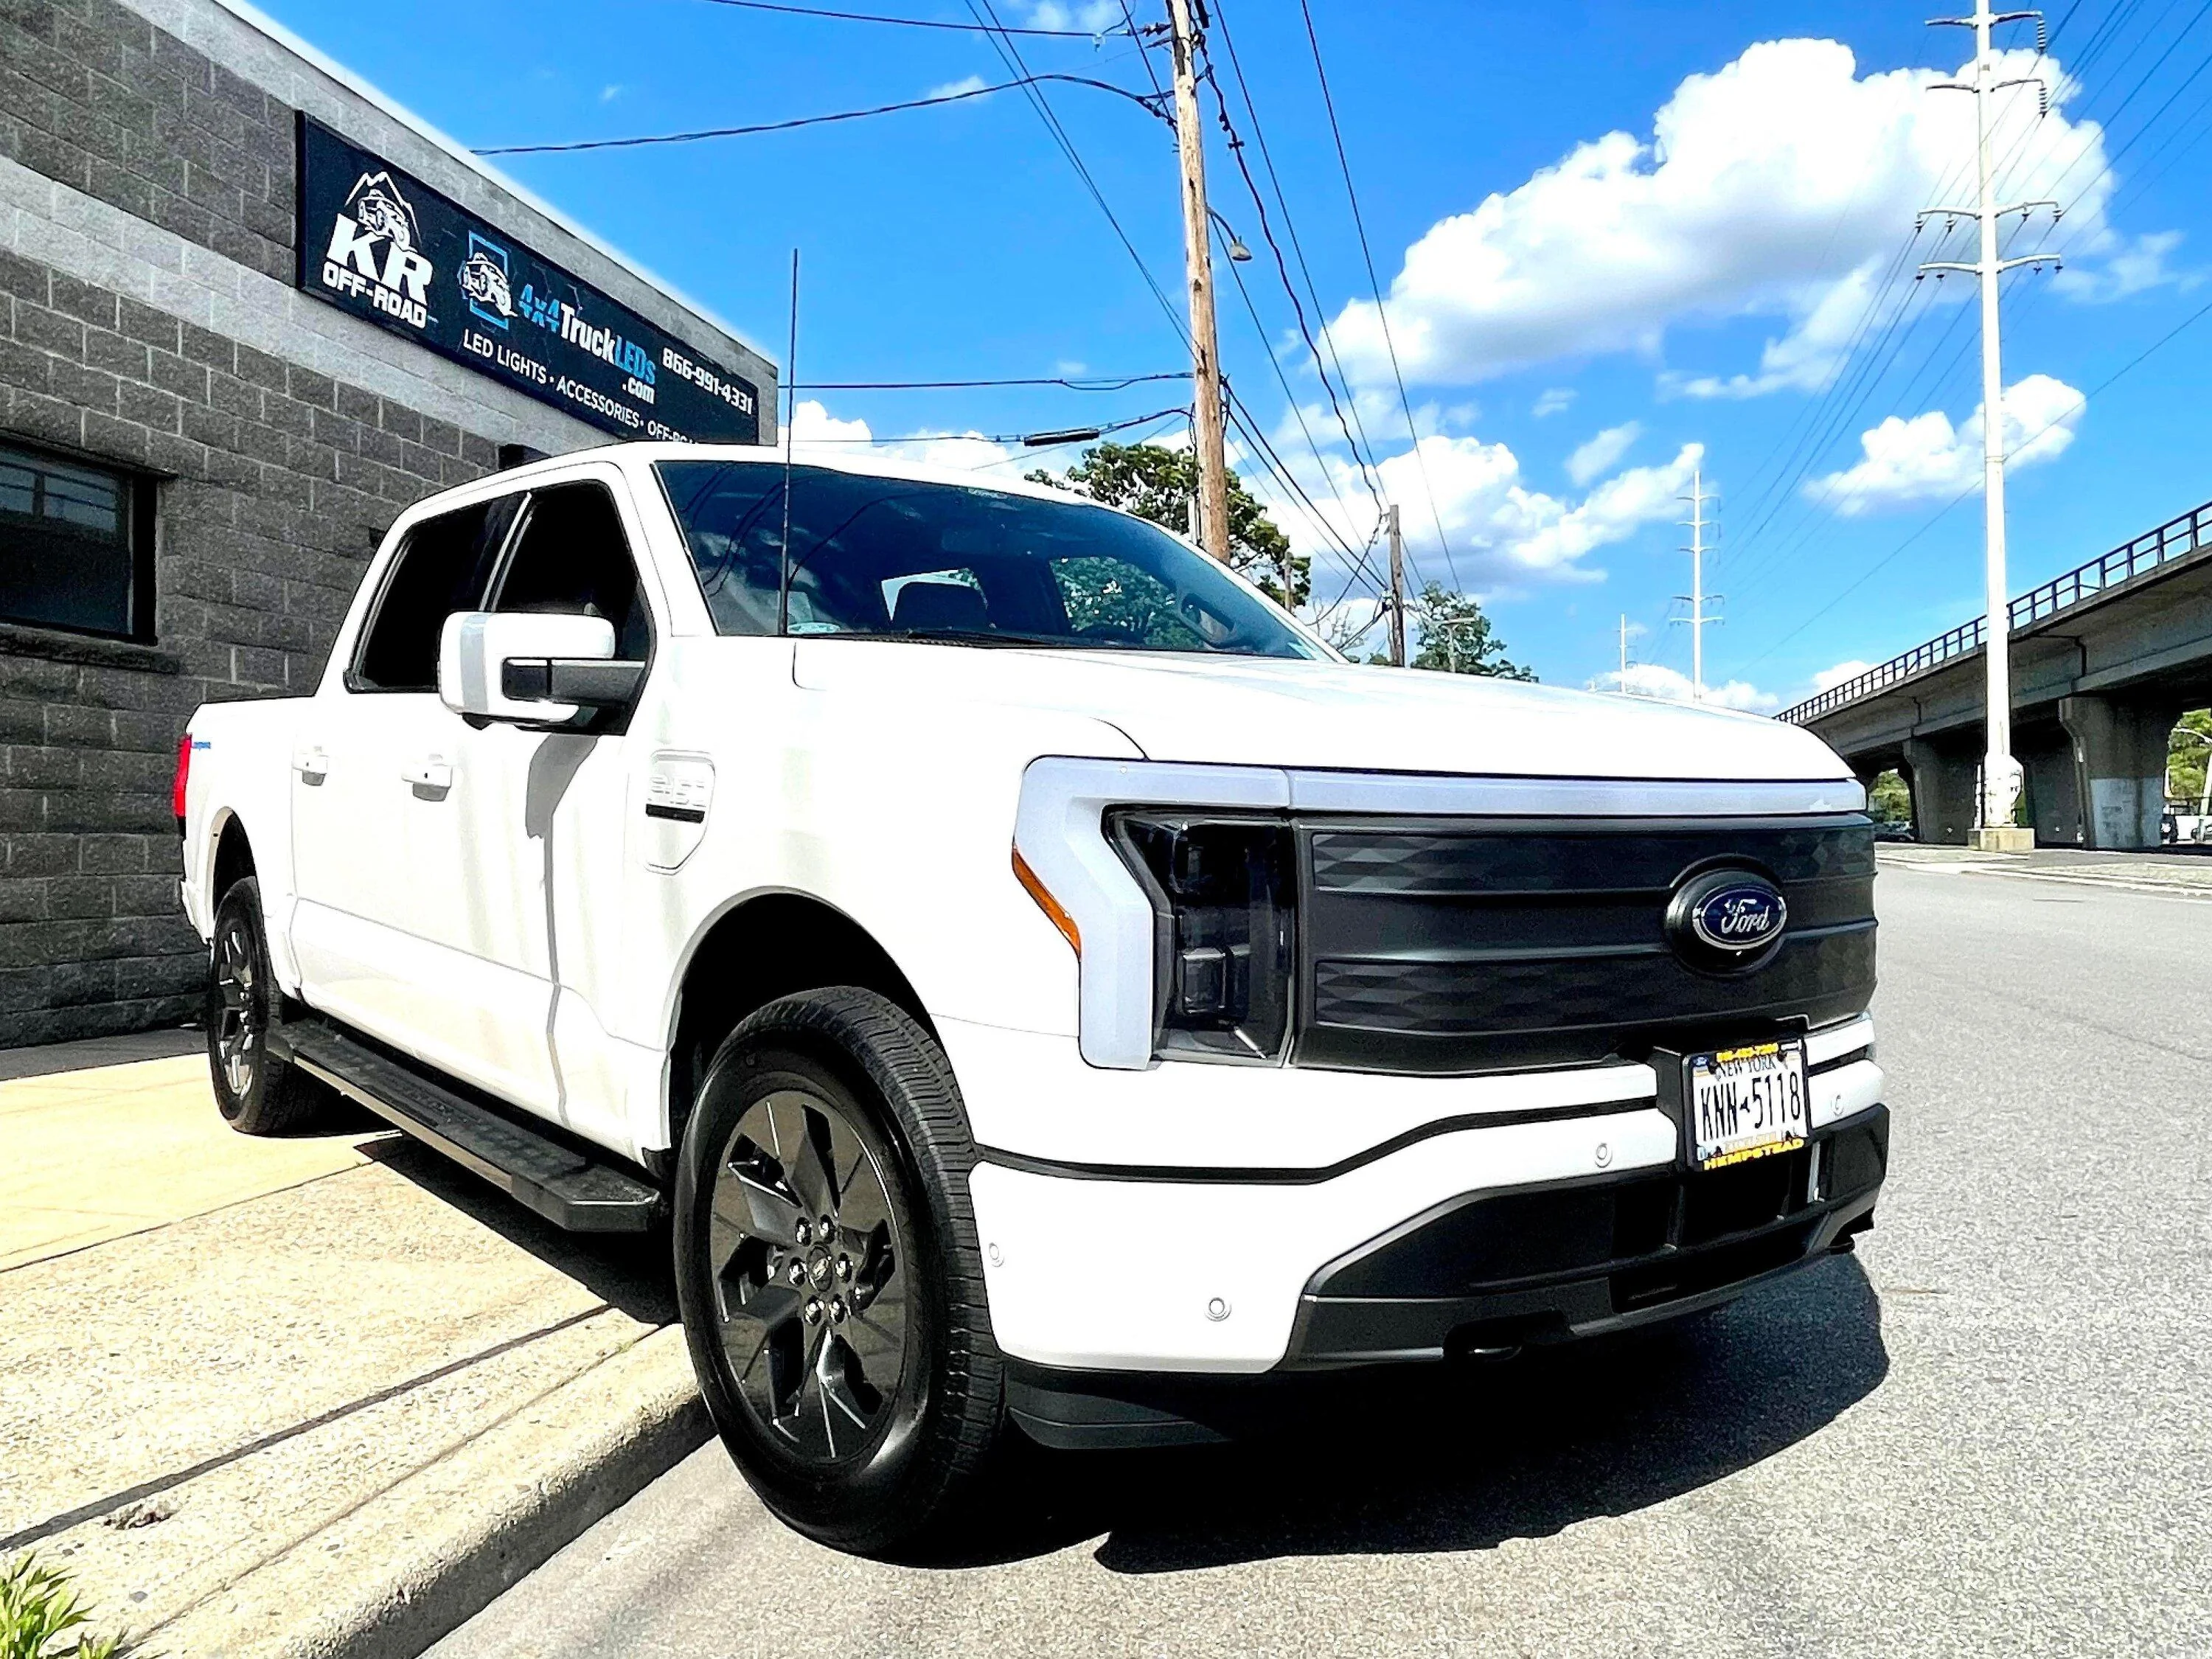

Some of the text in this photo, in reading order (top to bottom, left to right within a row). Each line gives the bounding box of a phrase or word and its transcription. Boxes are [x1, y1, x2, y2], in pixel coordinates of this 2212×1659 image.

[326, 212, 434, 306] KR
[322, 260, 428, 329] OFF-ROAD
[463, 328, 494, 358] LED
[497, 344, 547, 384] LIGHTS
[556, 375, 640, 428] ACCESSORIES
[663, 347, 753, 415] 866-991-4331
[1720, 898, 1770, 934] Ford
